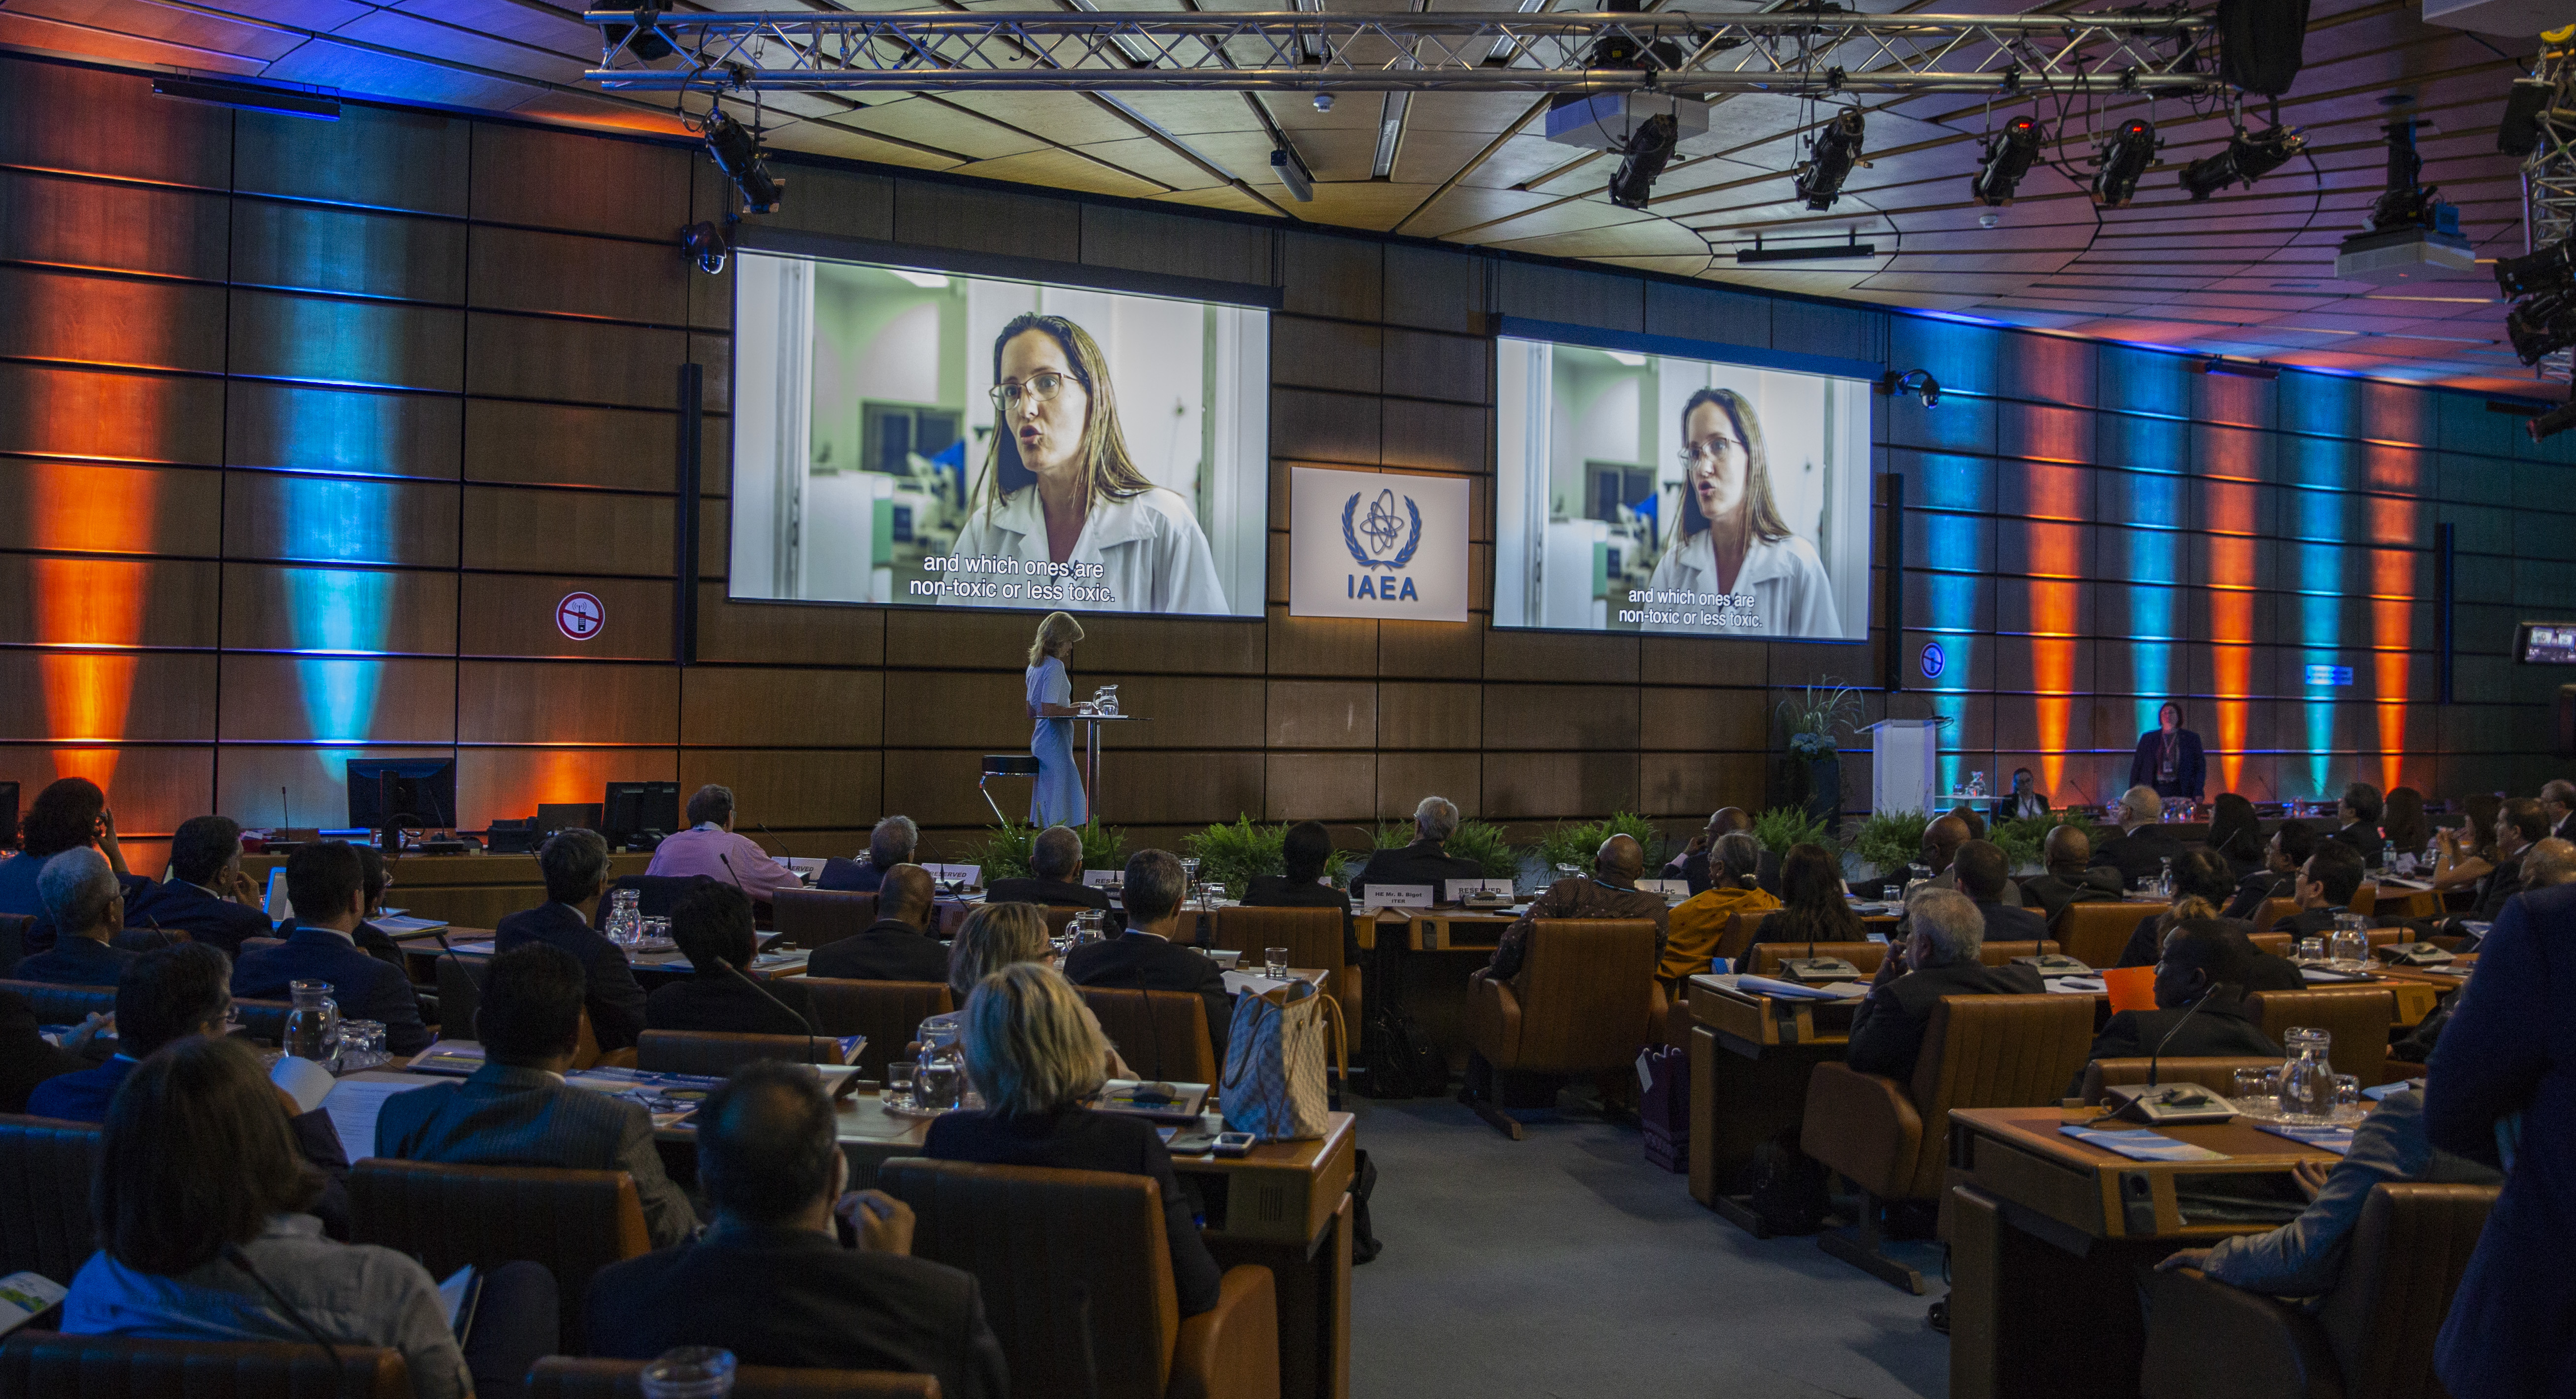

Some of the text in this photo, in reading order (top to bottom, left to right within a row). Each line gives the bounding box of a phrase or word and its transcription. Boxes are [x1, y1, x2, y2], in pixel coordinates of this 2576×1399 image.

[924, 553, 1104, 578] and which ones are
[910, 579, 1115, 602] non-toxic or less toxic.
[1348, 574, 1418, 601] IAEA
[1628, 587, 1755, 608] and which ones are
[1619, 608, 1763, 628] non-toxic or less toxic.
